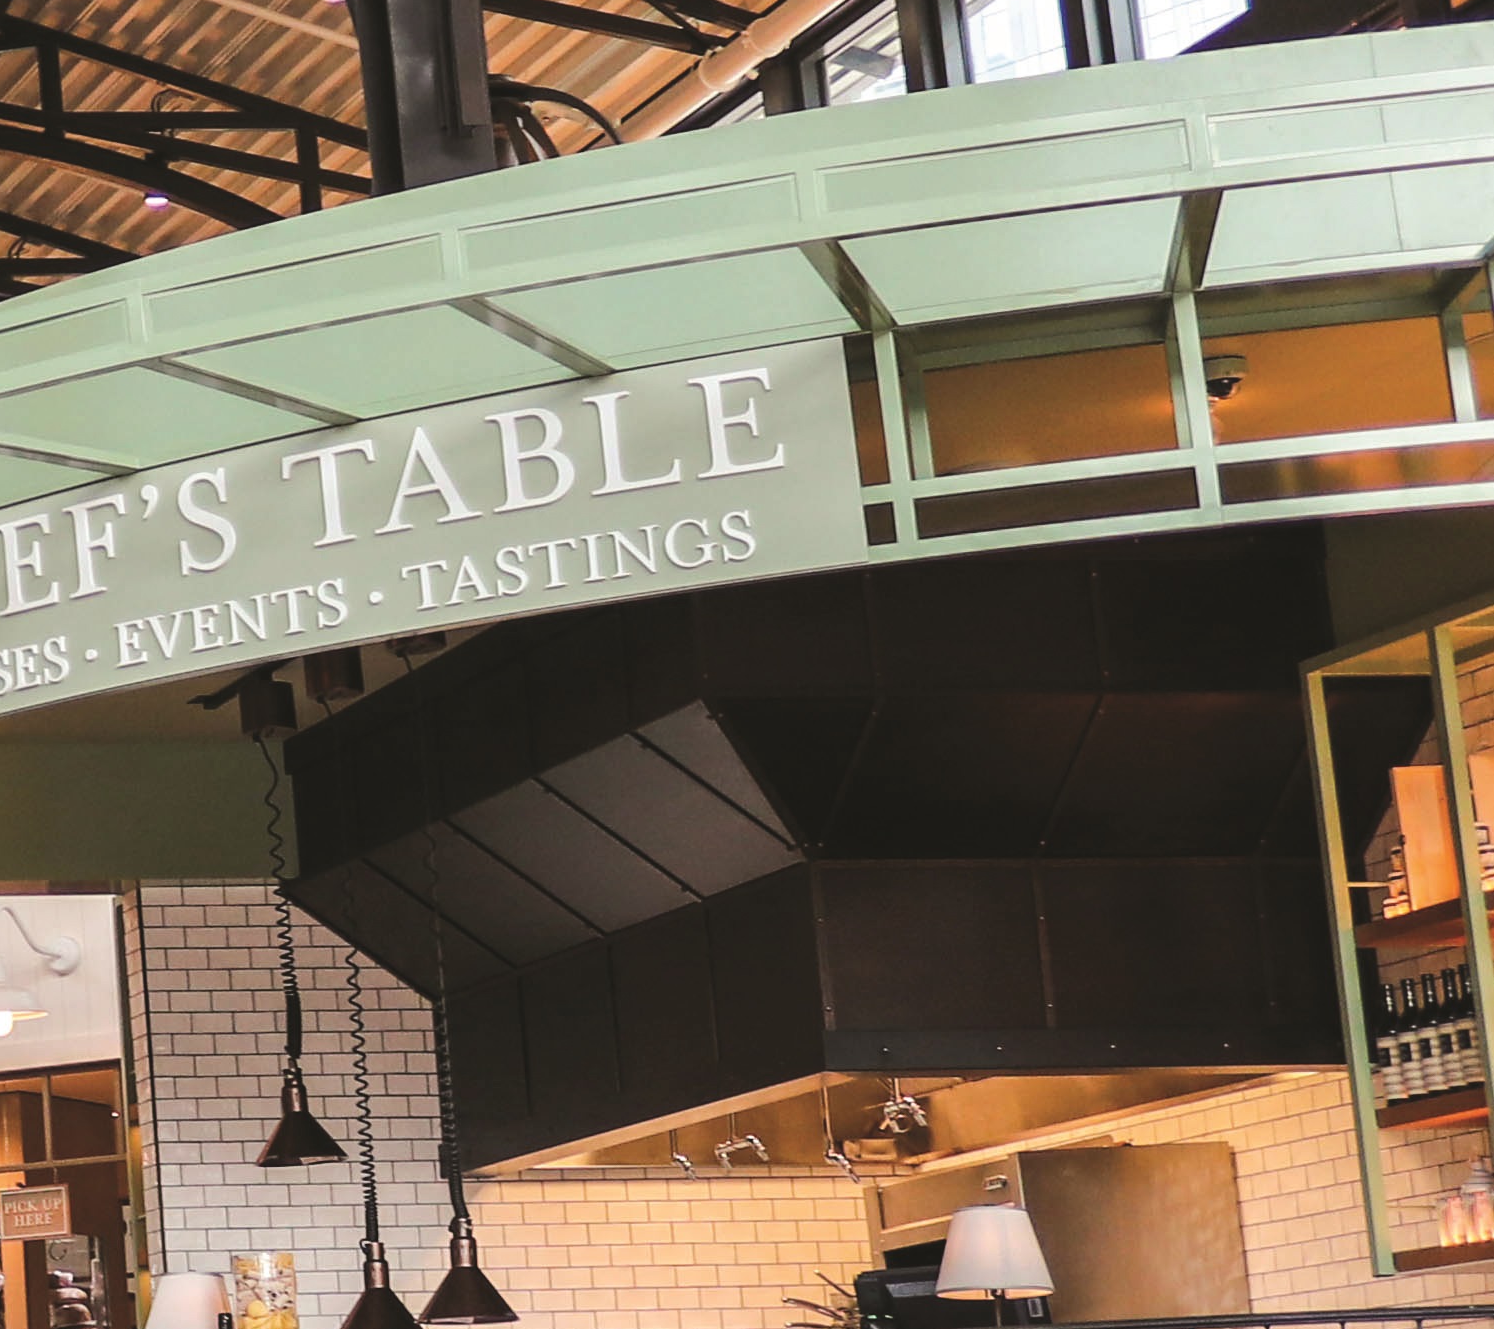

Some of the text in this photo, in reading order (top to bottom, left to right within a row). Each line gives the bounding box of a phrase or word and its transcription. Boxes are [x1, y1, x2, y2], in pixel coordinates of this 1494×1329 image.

[281, 366, 786, 550] TABLE
[116, 577, 349, 670] EVENTS
[401, 509, 759, 614] TASTINGS
[4, 1198, 62, 1214] PICK UP
[15, 1213, 54, 1227] HERE
